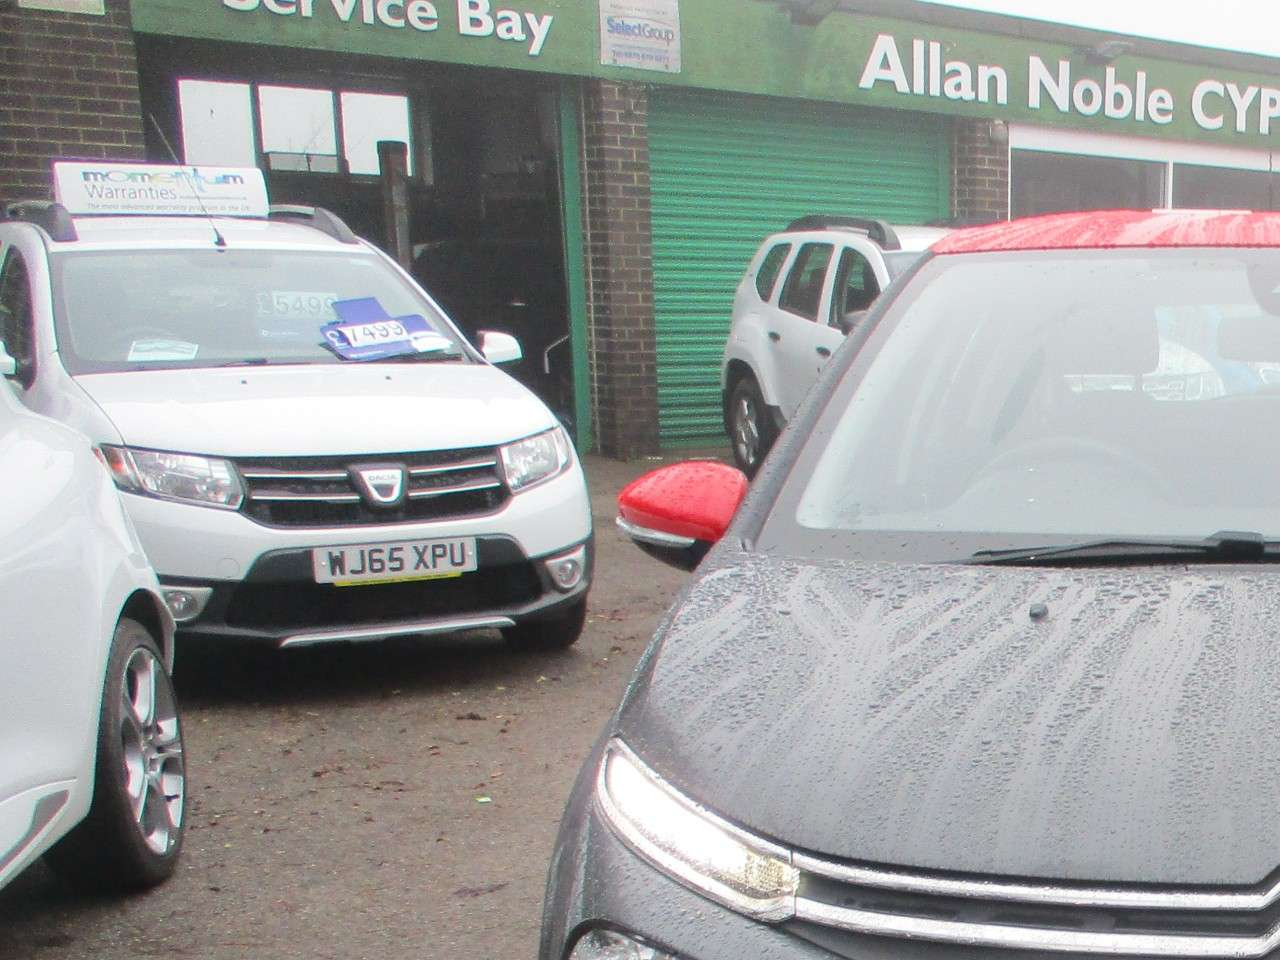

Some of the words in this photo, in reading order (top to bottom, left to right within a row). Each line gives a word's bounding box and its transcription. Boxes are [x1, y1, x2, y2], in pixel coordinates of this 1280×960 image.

[223, 0, 438, 31] rvice
[458, 0, 553, 56] Bay
[858, 33, 1008, 105] Allan
[1028, 55, 1174, 124] Noble
[84, 184, 177, 200] Warranties
[328, 547, 404, 576] WJ65
[413, 542, 465, 570] XPU
